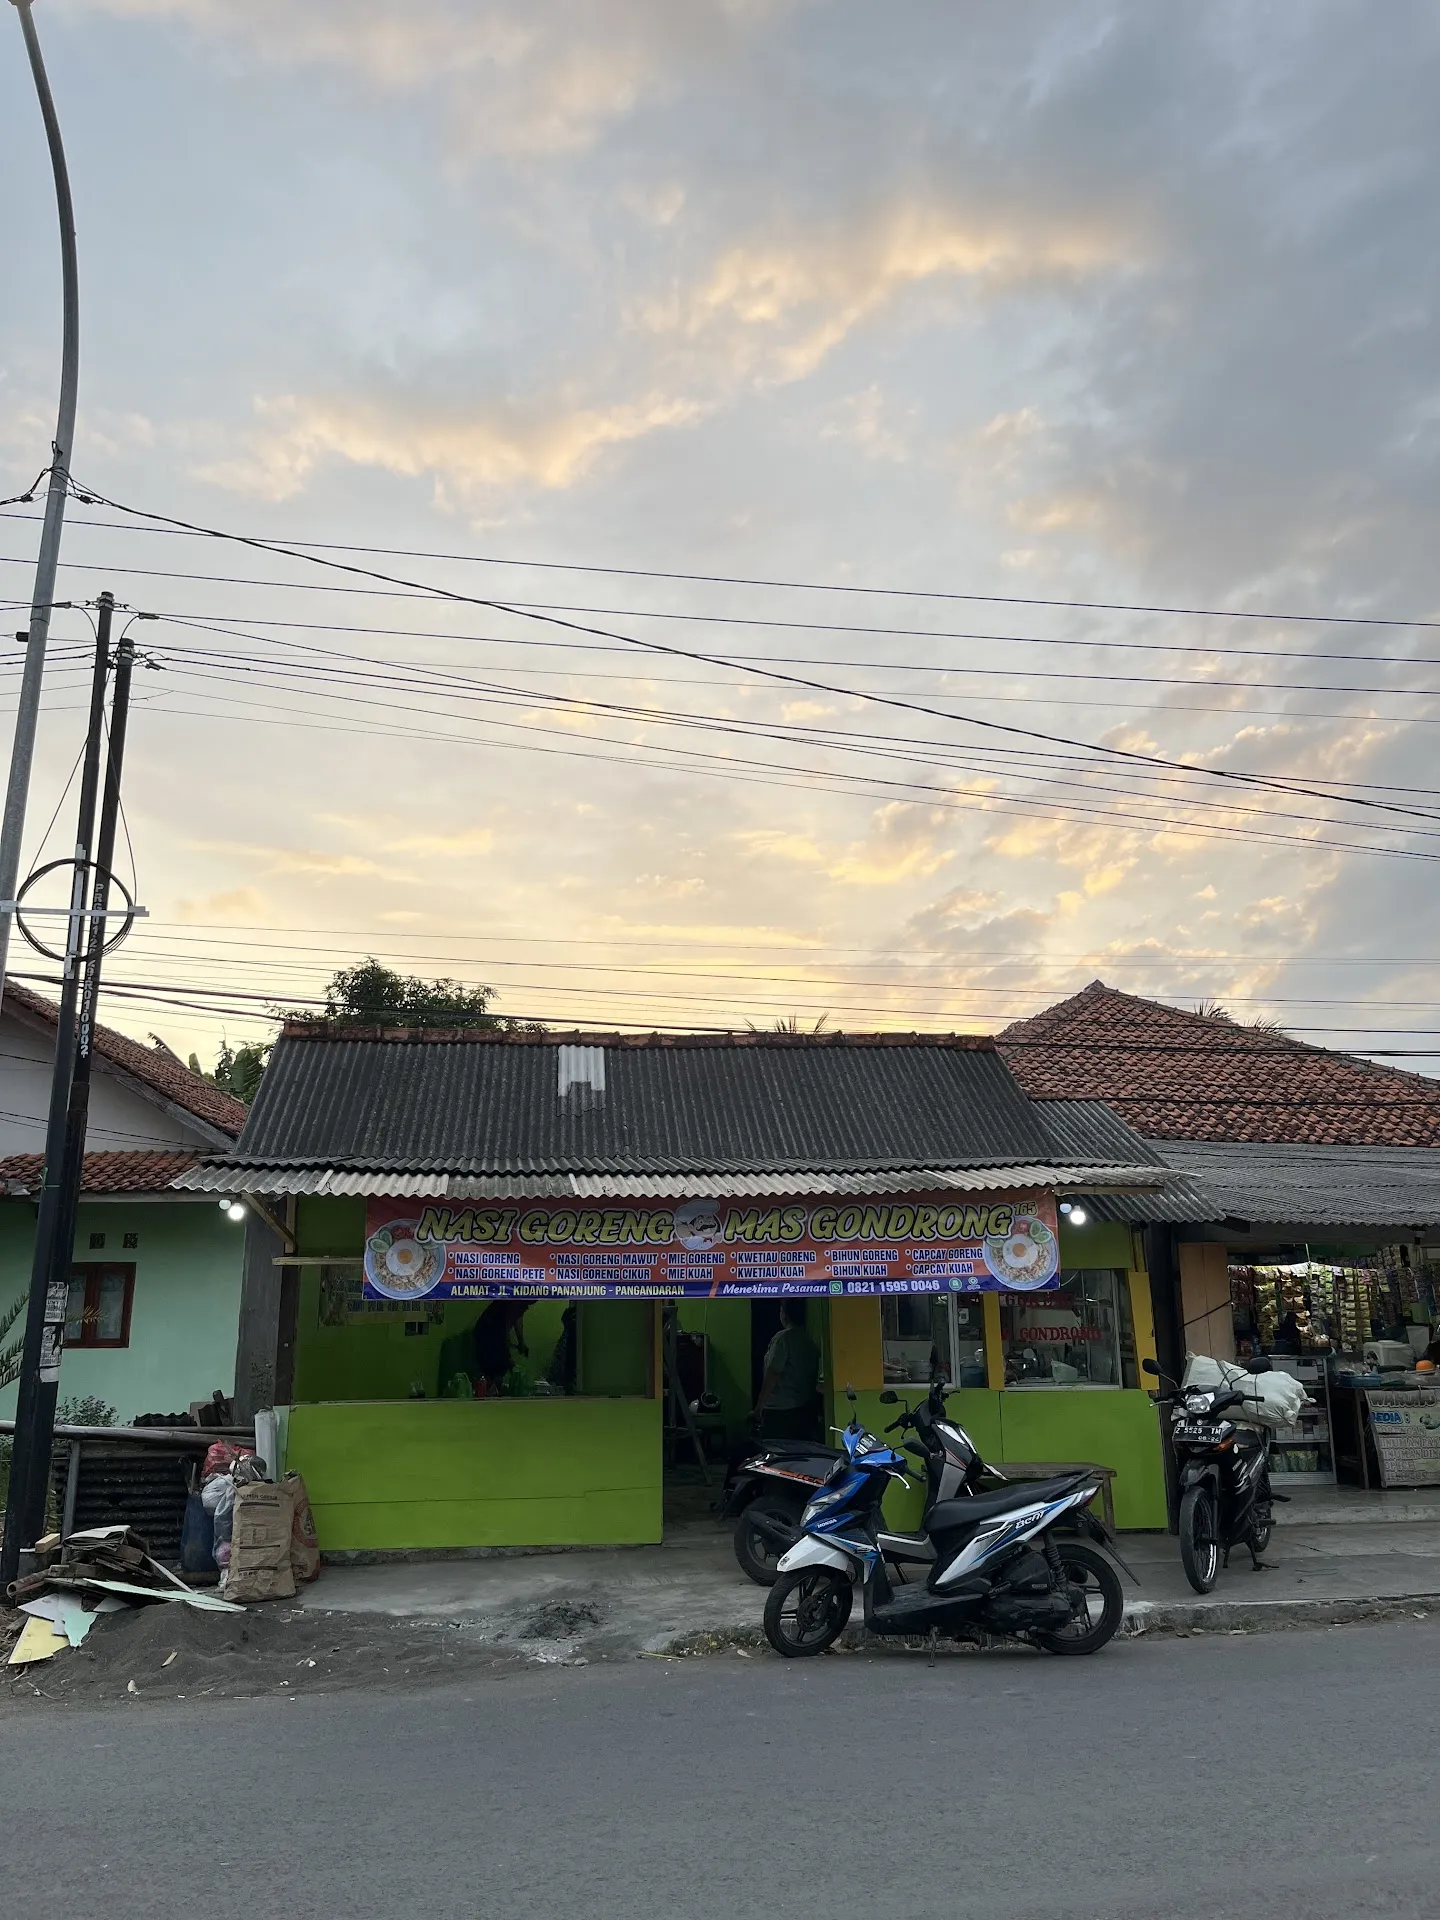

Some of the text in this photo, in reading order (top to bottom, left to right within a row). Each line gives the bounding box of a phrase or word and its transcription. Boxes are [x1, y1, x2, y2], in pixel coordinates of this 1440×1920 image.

[1014, 1201, 1037, 1216] 165
[416, 1204, 1013, 1244] NASI GORENG MAS GONDRONG
[455, 1253, 520, 1264] NASI GORENG
[557, 1253, 658, 1265] NASI GORENG MAWUT
[668, 1252, 725, 1264] MIE GORENG
[737, 1251, 816, 1263] KWETIAU GORENG
[832, 1249, 898, 1261] BIHUN GORENG
[913, 1248, 983, 1260] CAPCAY GORENG
[455, 1268, 545, 1279] NASI GORENG PETE
[557, 1268, 650, 1279] NASI GORENG CIKUR
[668, 1267, 713, 1279] MIE KUAH
[737, 1266, 804, 1278] KWETIAU KUAH
[833, 1264, 887, 1276] BIHUN KUAH
[913, 1262, 973, 1275] CAPCAY KUAH
[450, 1285, 490, 1296] ALAMAT
[513, 1285, 549, 1296] KIDANG
[551, 1285, 606, 1296] PANANJUNG
[615, 1285, 685, 1296] PANGANDARAN
[722, 1280, 940, 1294] Menerima Pesanan 0821 1595 0046
[1371, 1411, 1402, 1424] EDIA
